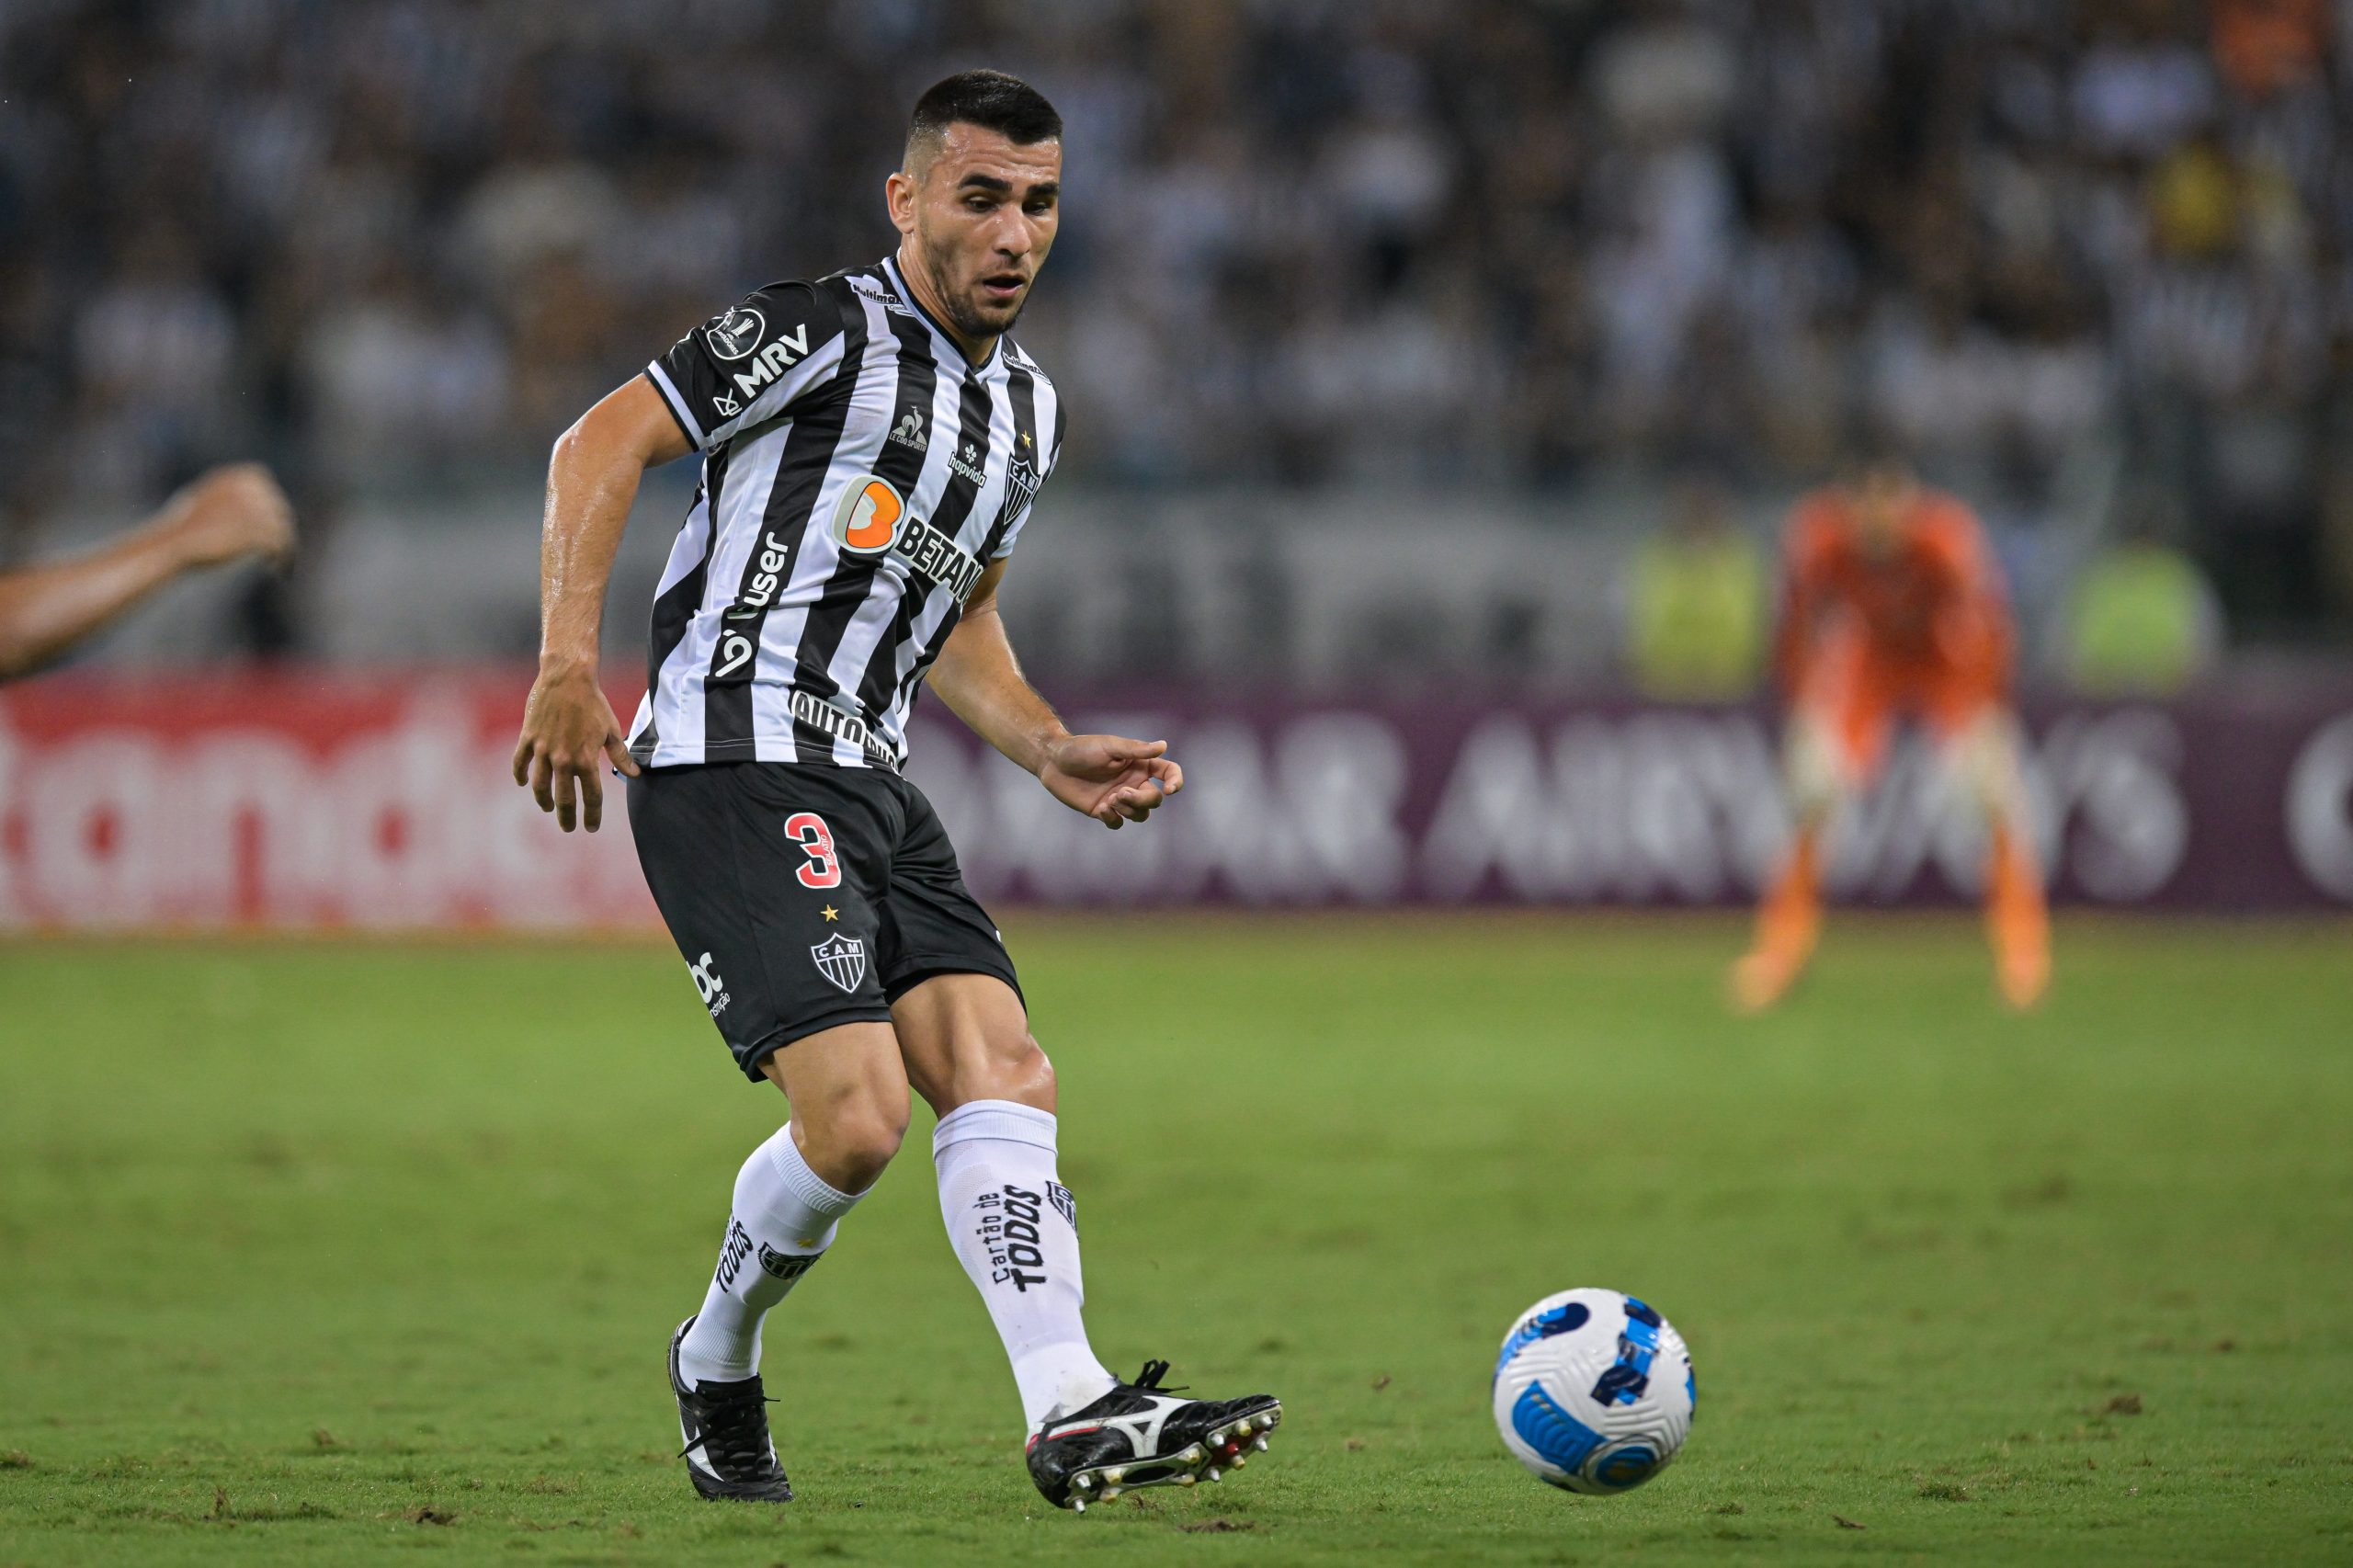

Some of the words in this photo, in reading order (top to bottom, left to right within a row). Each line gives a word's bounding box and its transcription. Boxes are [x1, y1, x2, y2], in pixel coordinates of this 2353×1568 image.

[733, 324, 808, 399] MRV
[889, 432, 897, 441] LE
[907, 439, 927, 452] SPORTIF
[948, 451, 987, 488] hapvida
[1012, 463, 1036, 491] CAM
[893, 515, 983, 602] BETAN
[784, 812, 842, 889] 3
[818, 941, 859, 959] CAM
[972, 1193, 1000, 1209] de
[716, 1221, 754, 1294] TODOS
[976, 1215, 1010, 1284] Cartão
[1004, 1185, 1046, 1292] TODOS
